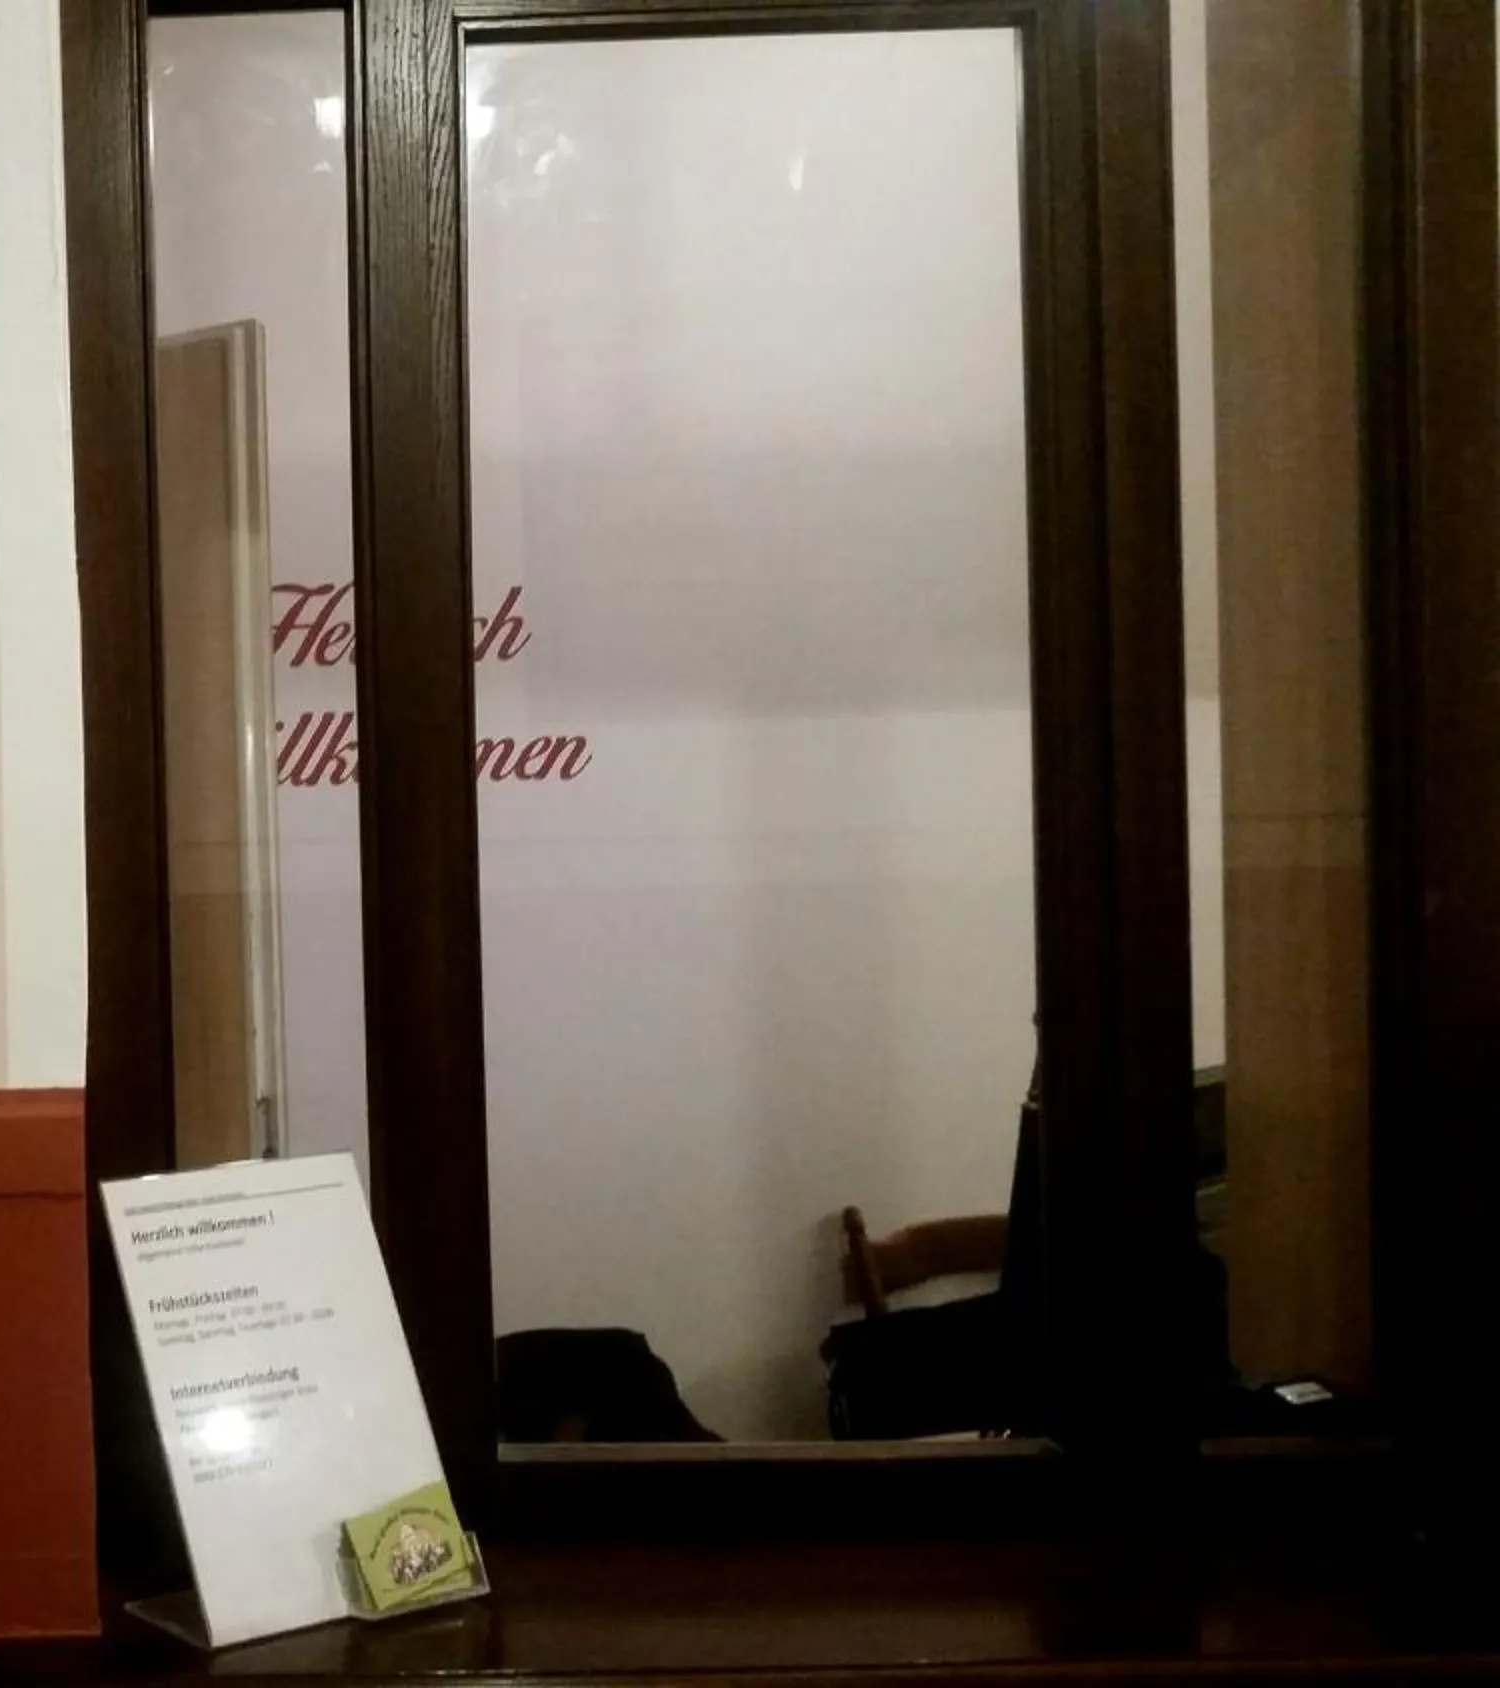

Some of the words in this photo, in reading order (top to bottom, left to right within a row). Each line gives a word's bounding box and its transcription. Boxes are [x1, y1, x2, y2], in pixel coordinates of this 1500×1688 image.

[271, 582, 531, 667] Hech
[275, 711, 592, 787] illkmen
[130, 1223, 185, 1245] Herzlich
[188, 1214, 266, 1238] willkommen
[148, 1285, 259, 1314] Frühstückszeiten
